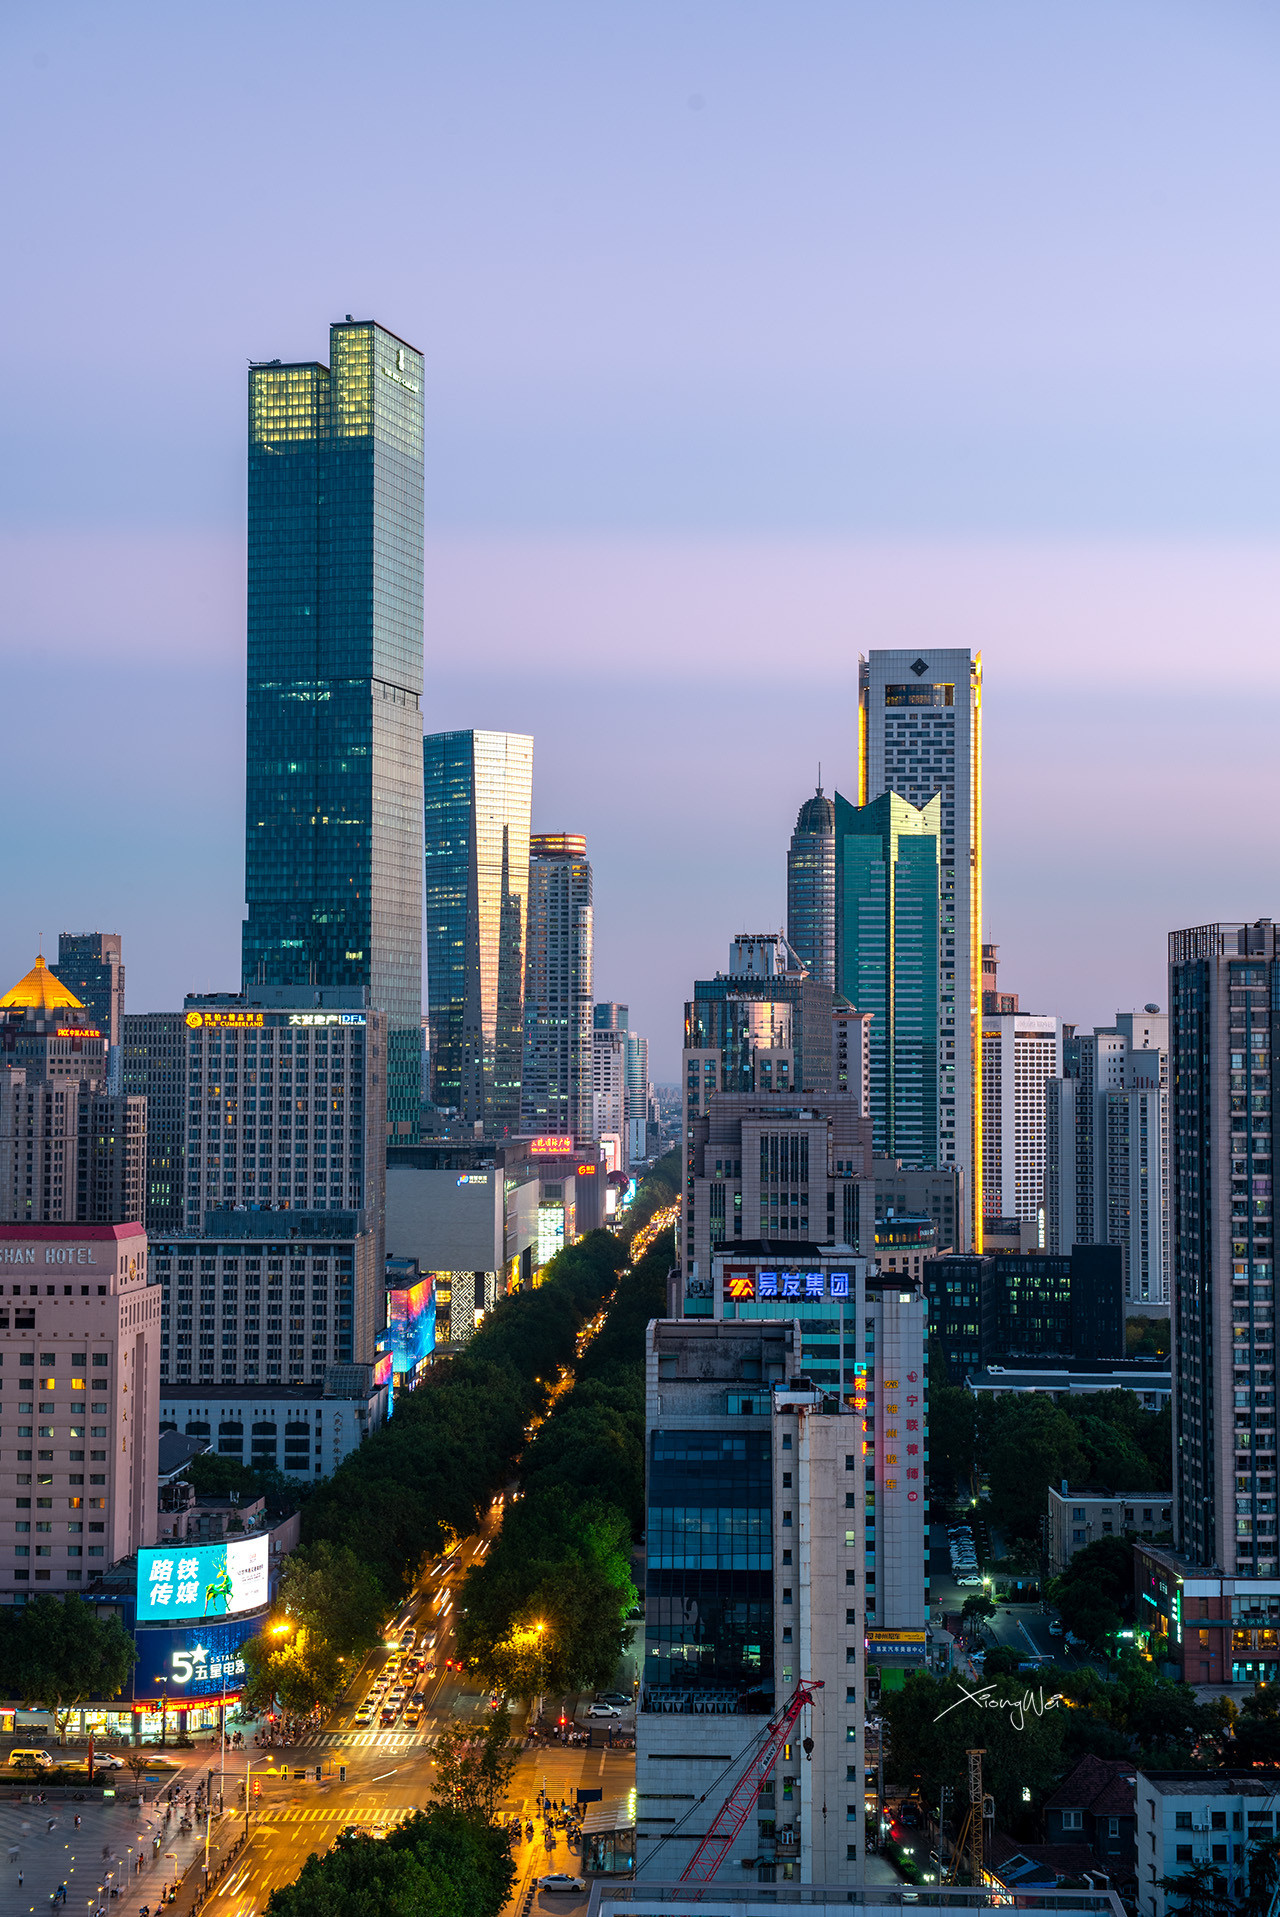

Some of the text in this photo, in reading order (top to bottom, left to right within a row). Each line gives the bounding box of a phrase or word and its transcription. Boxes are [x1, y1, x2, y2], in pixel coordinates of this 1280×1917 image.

[289, 1014, 338, 1025] 大发地产
[45, 1247, 97, 1264] HOTEL
[758, 1272, 849, 1297] 易发集团
[886, 1404, 897, 1489] 神州租车
[906, 1395, 918, 1480] 宁联律师
[149, 1558, 199, 1581] 路铁
[149, 1581, 199, 1605] 传媒
[195, 1658, 245, 1680] 五星电器
[762, 1746, 776, 1766] SANY
